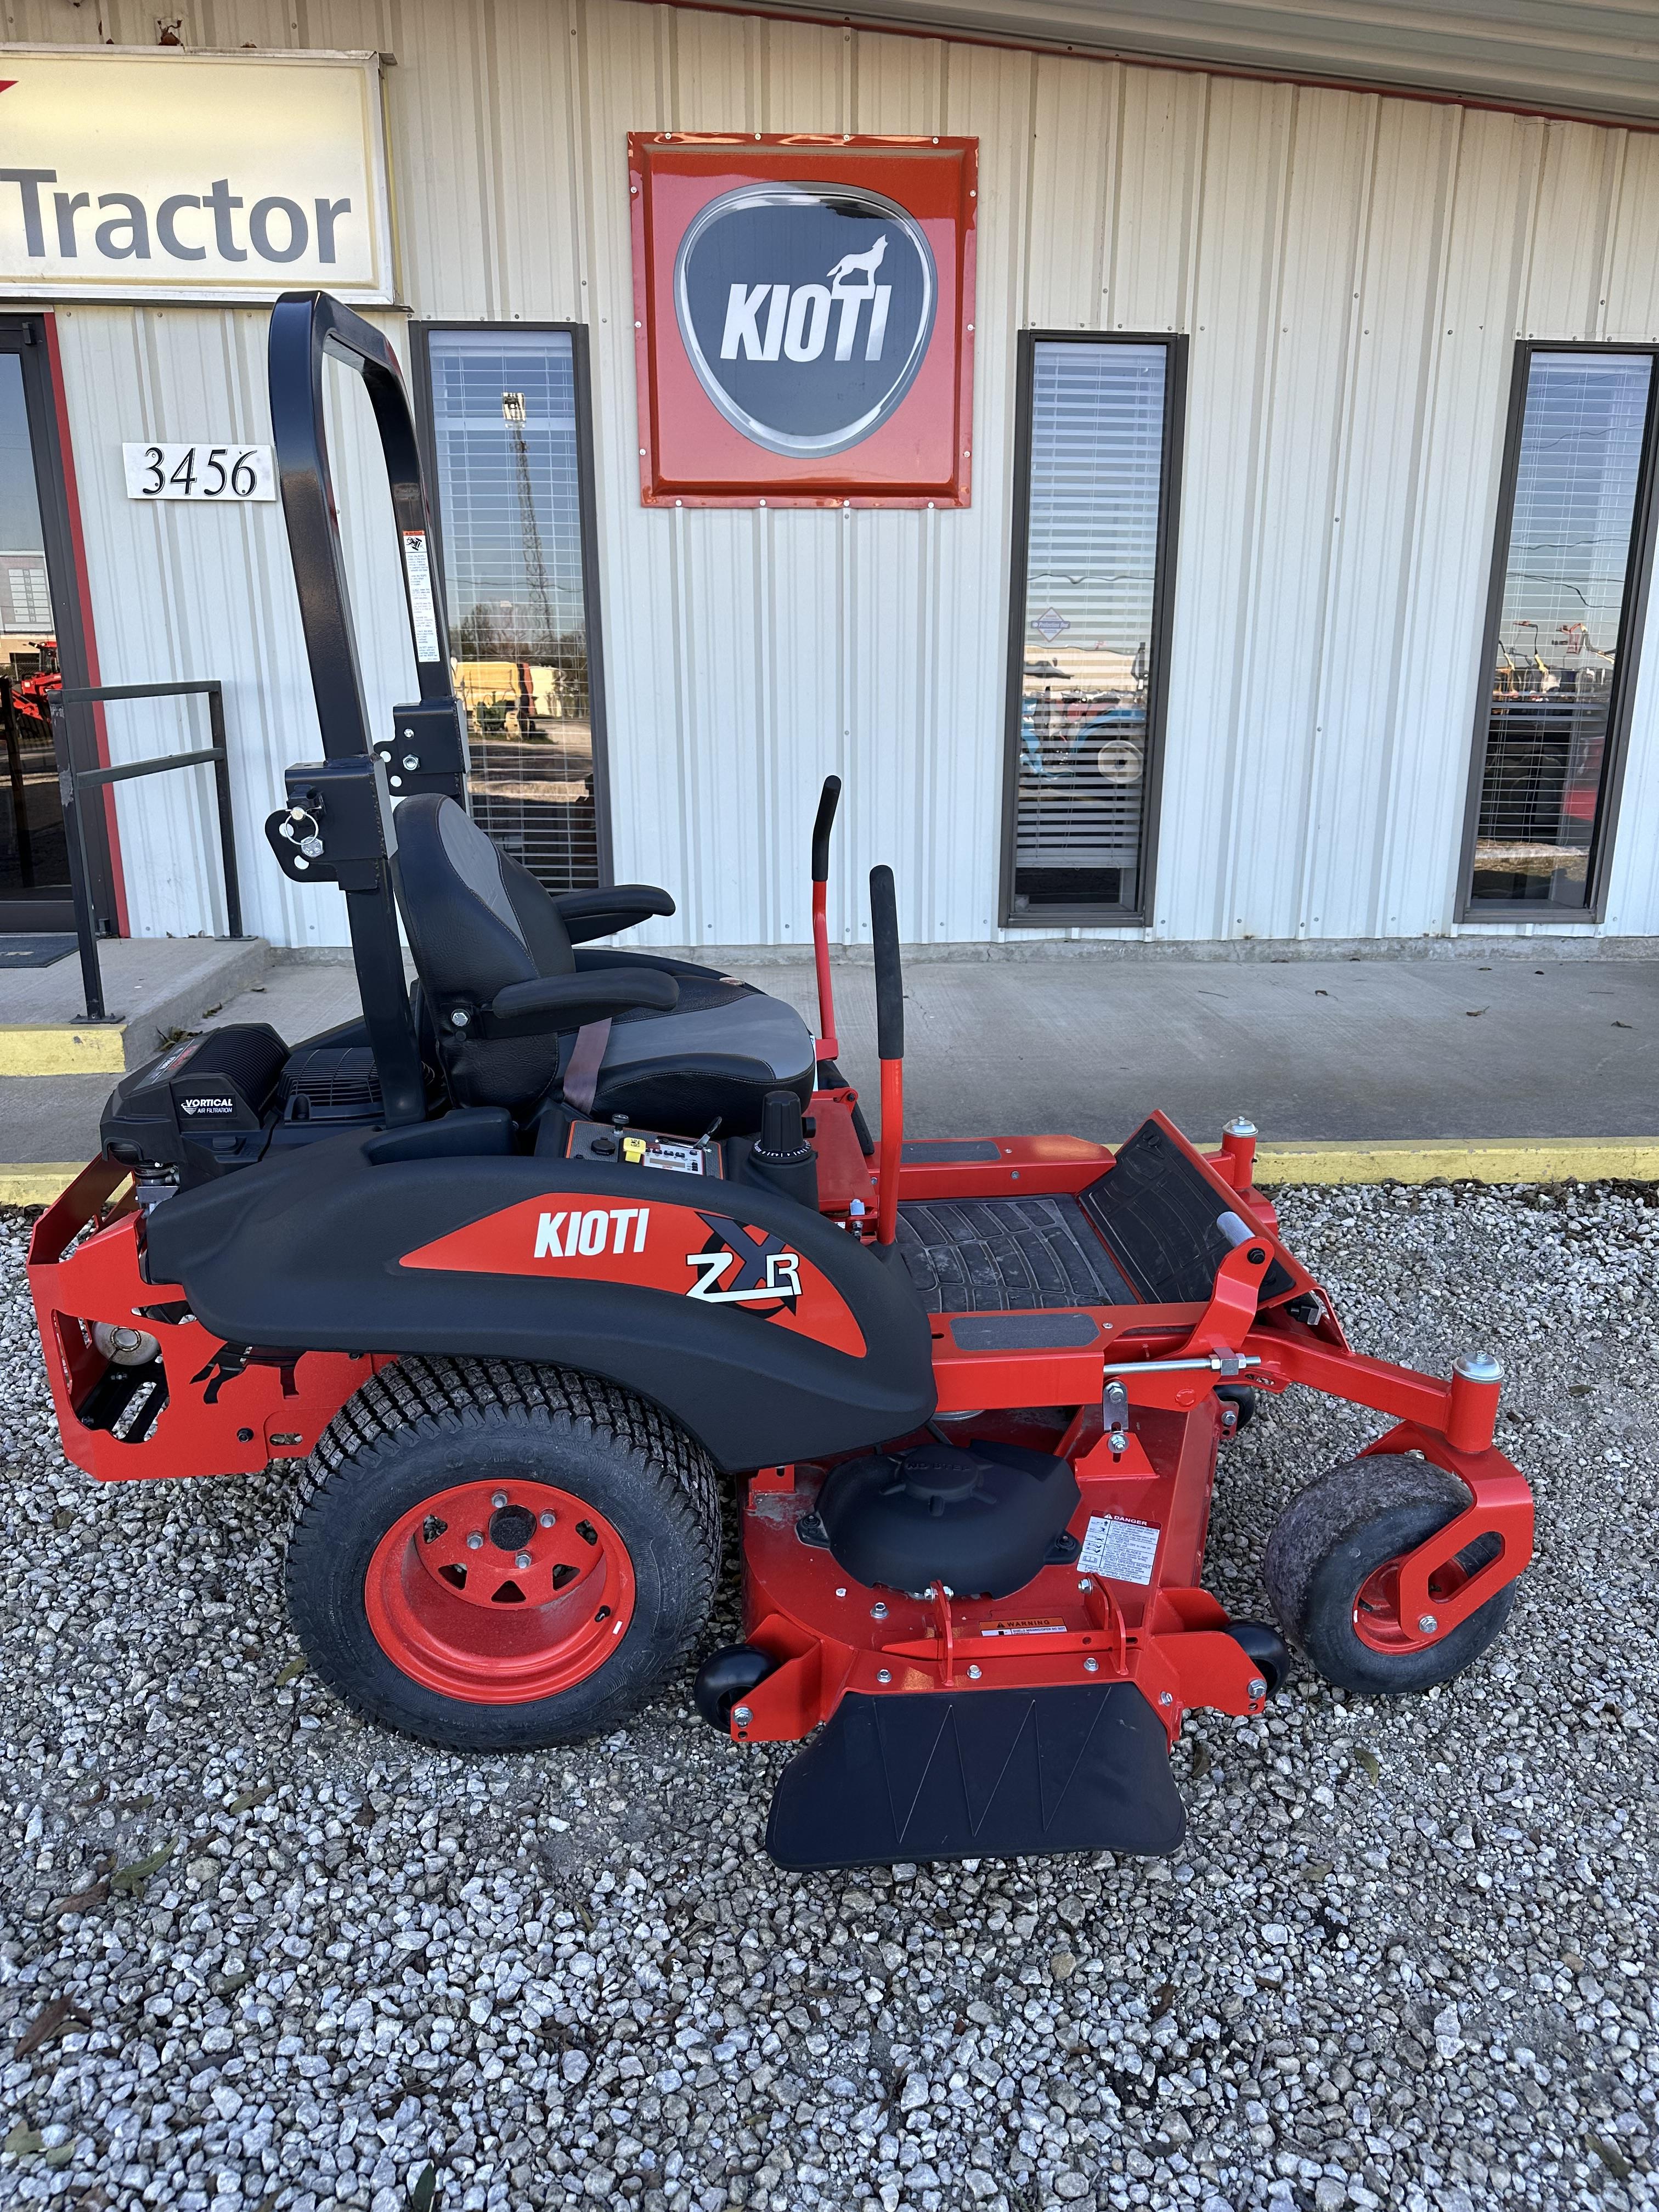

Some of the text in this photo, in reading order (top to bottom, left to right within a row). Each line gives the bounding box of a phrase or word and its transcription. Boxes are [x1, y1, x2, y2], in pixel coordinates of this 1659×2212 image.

[0, 168, 352, 264] Tractor
[720, 283, 893, 362] KIOTI
[143, 447, 258, 496] 3456
[185, 1099, 233, 1107] VORTICAL
[533, 1208, 650, 1258] KIOTI
[1114, 1516, 1147, 1525] DANGER
